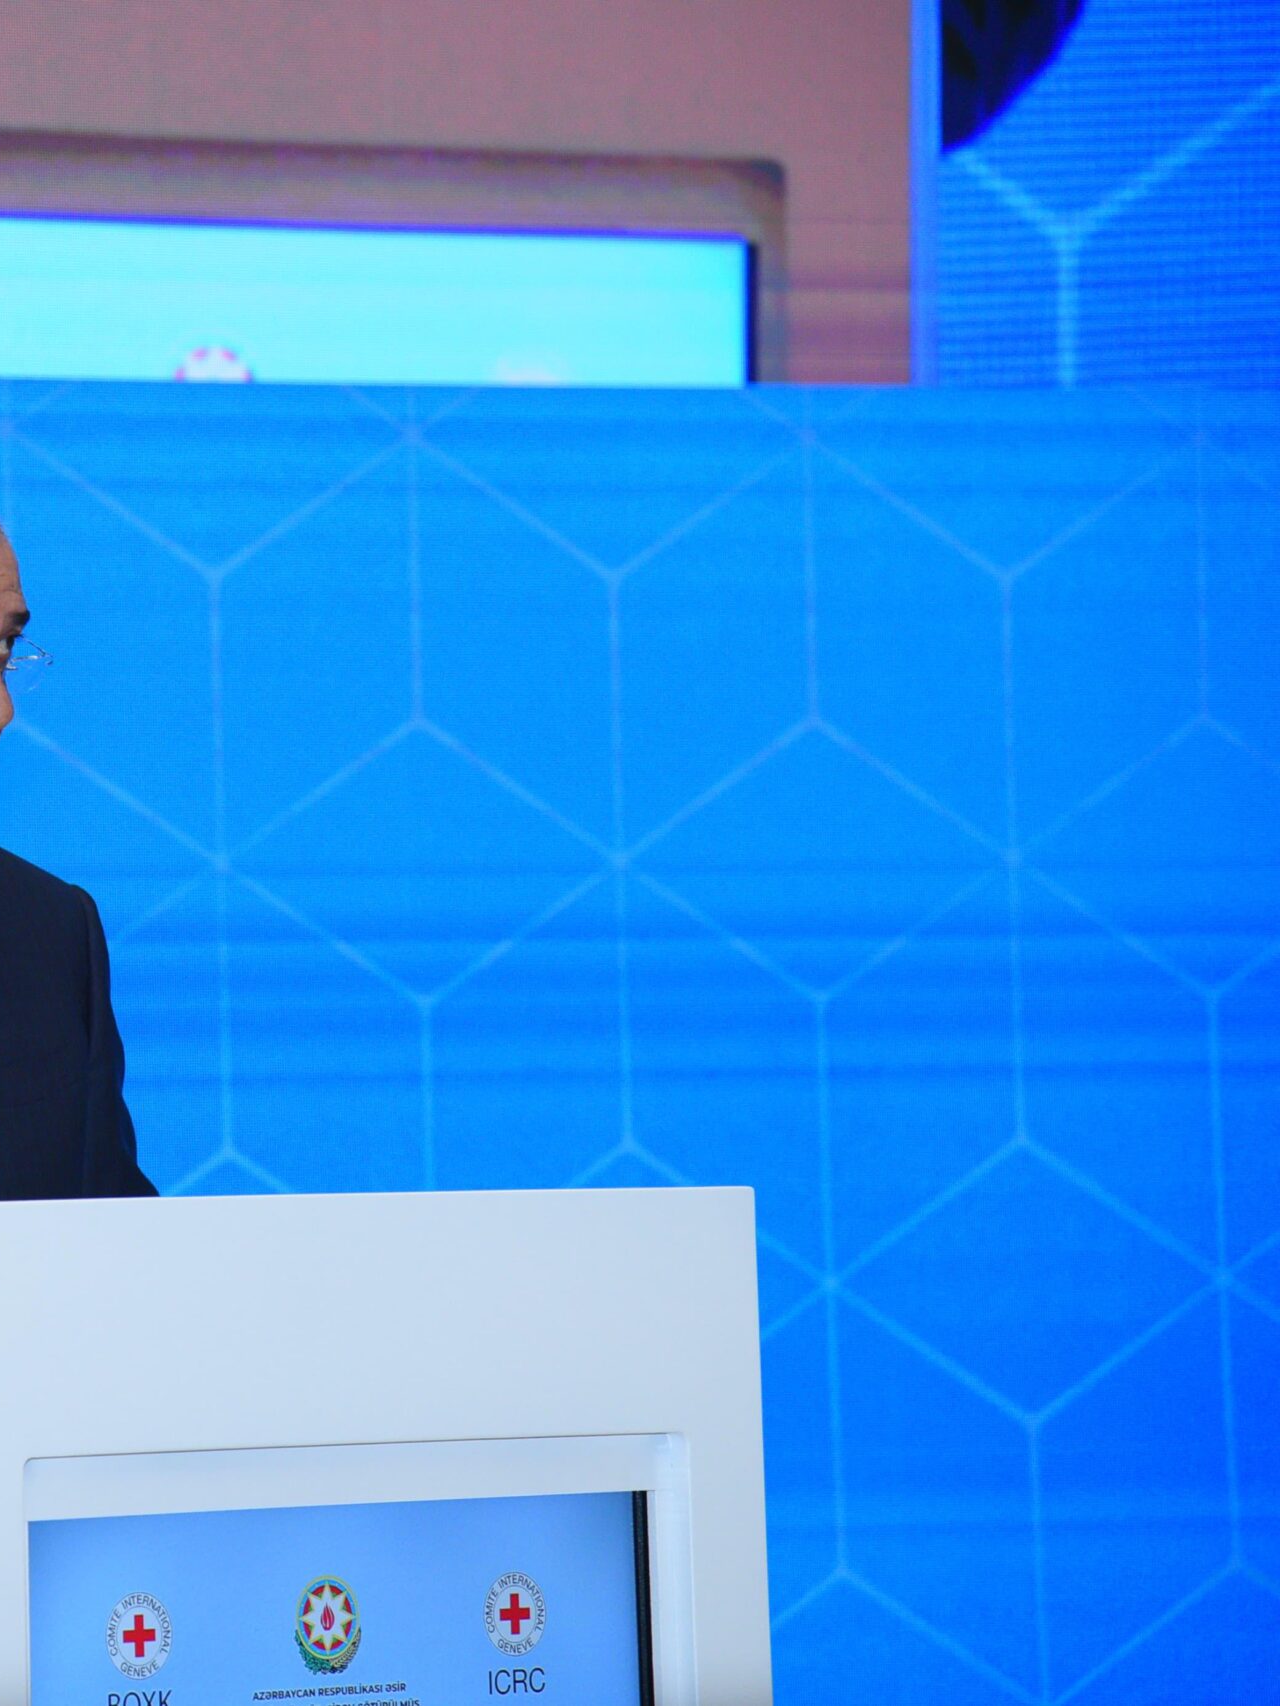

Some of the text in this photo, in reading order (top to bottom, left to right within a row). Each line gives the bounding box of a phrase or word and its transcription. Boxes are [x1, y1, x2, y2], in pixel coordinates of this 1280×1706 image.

[121, 1595, 171, 1653] INTERNATIONAL
[498, 1574, 545, 1632] INTERNATIONAL
[252, 1688, 316, 1701] AZƏRBAYCAN
[488, 1667, 545, 1695] ICRC
